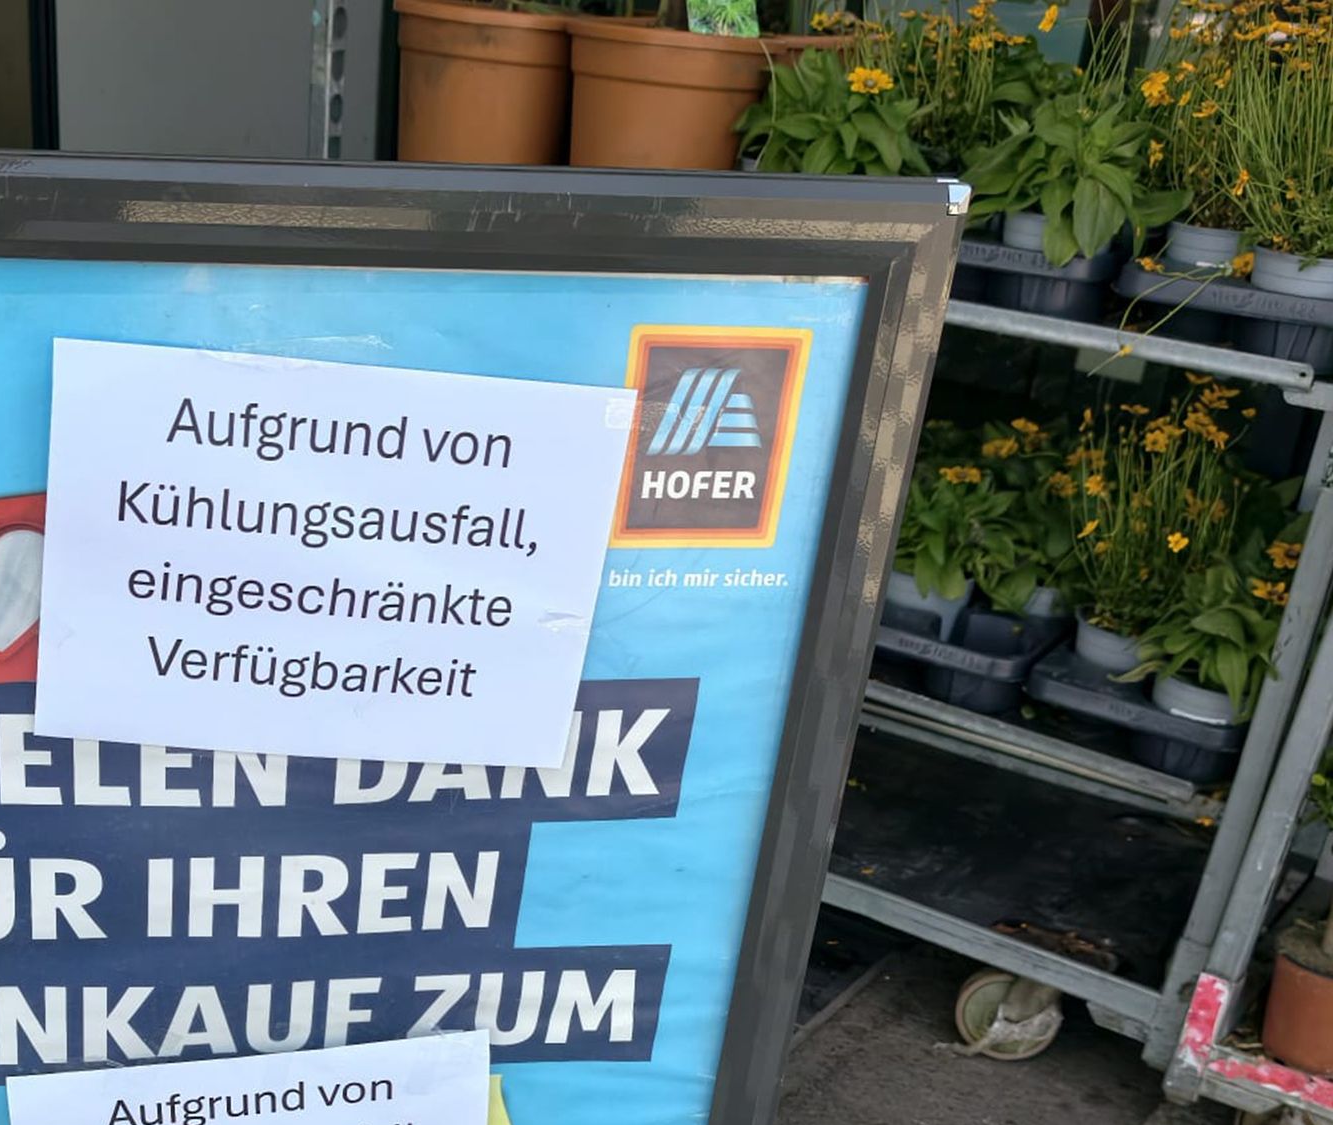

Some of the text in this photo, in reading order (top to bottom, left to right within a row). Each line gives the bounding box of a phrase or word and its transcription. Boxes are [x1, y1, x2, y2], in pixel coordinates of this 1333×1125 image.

[166, 397, 512, 468] Aufgrund von
[117, 480, 539, 557] Kühlungsausfall,
[640, 470, 757, 500] HOFER
[127, 561, 513, 628] eingeschränkte
[608, 568, 789, 588] bin ich mir sicher.
[147, 636, 477, 698] Verfügbarkeit
[145, 850, 500, 940] IHREN
[405, 968, 637, 1046] ZUM
[317, 1078, 394, 1104] von
